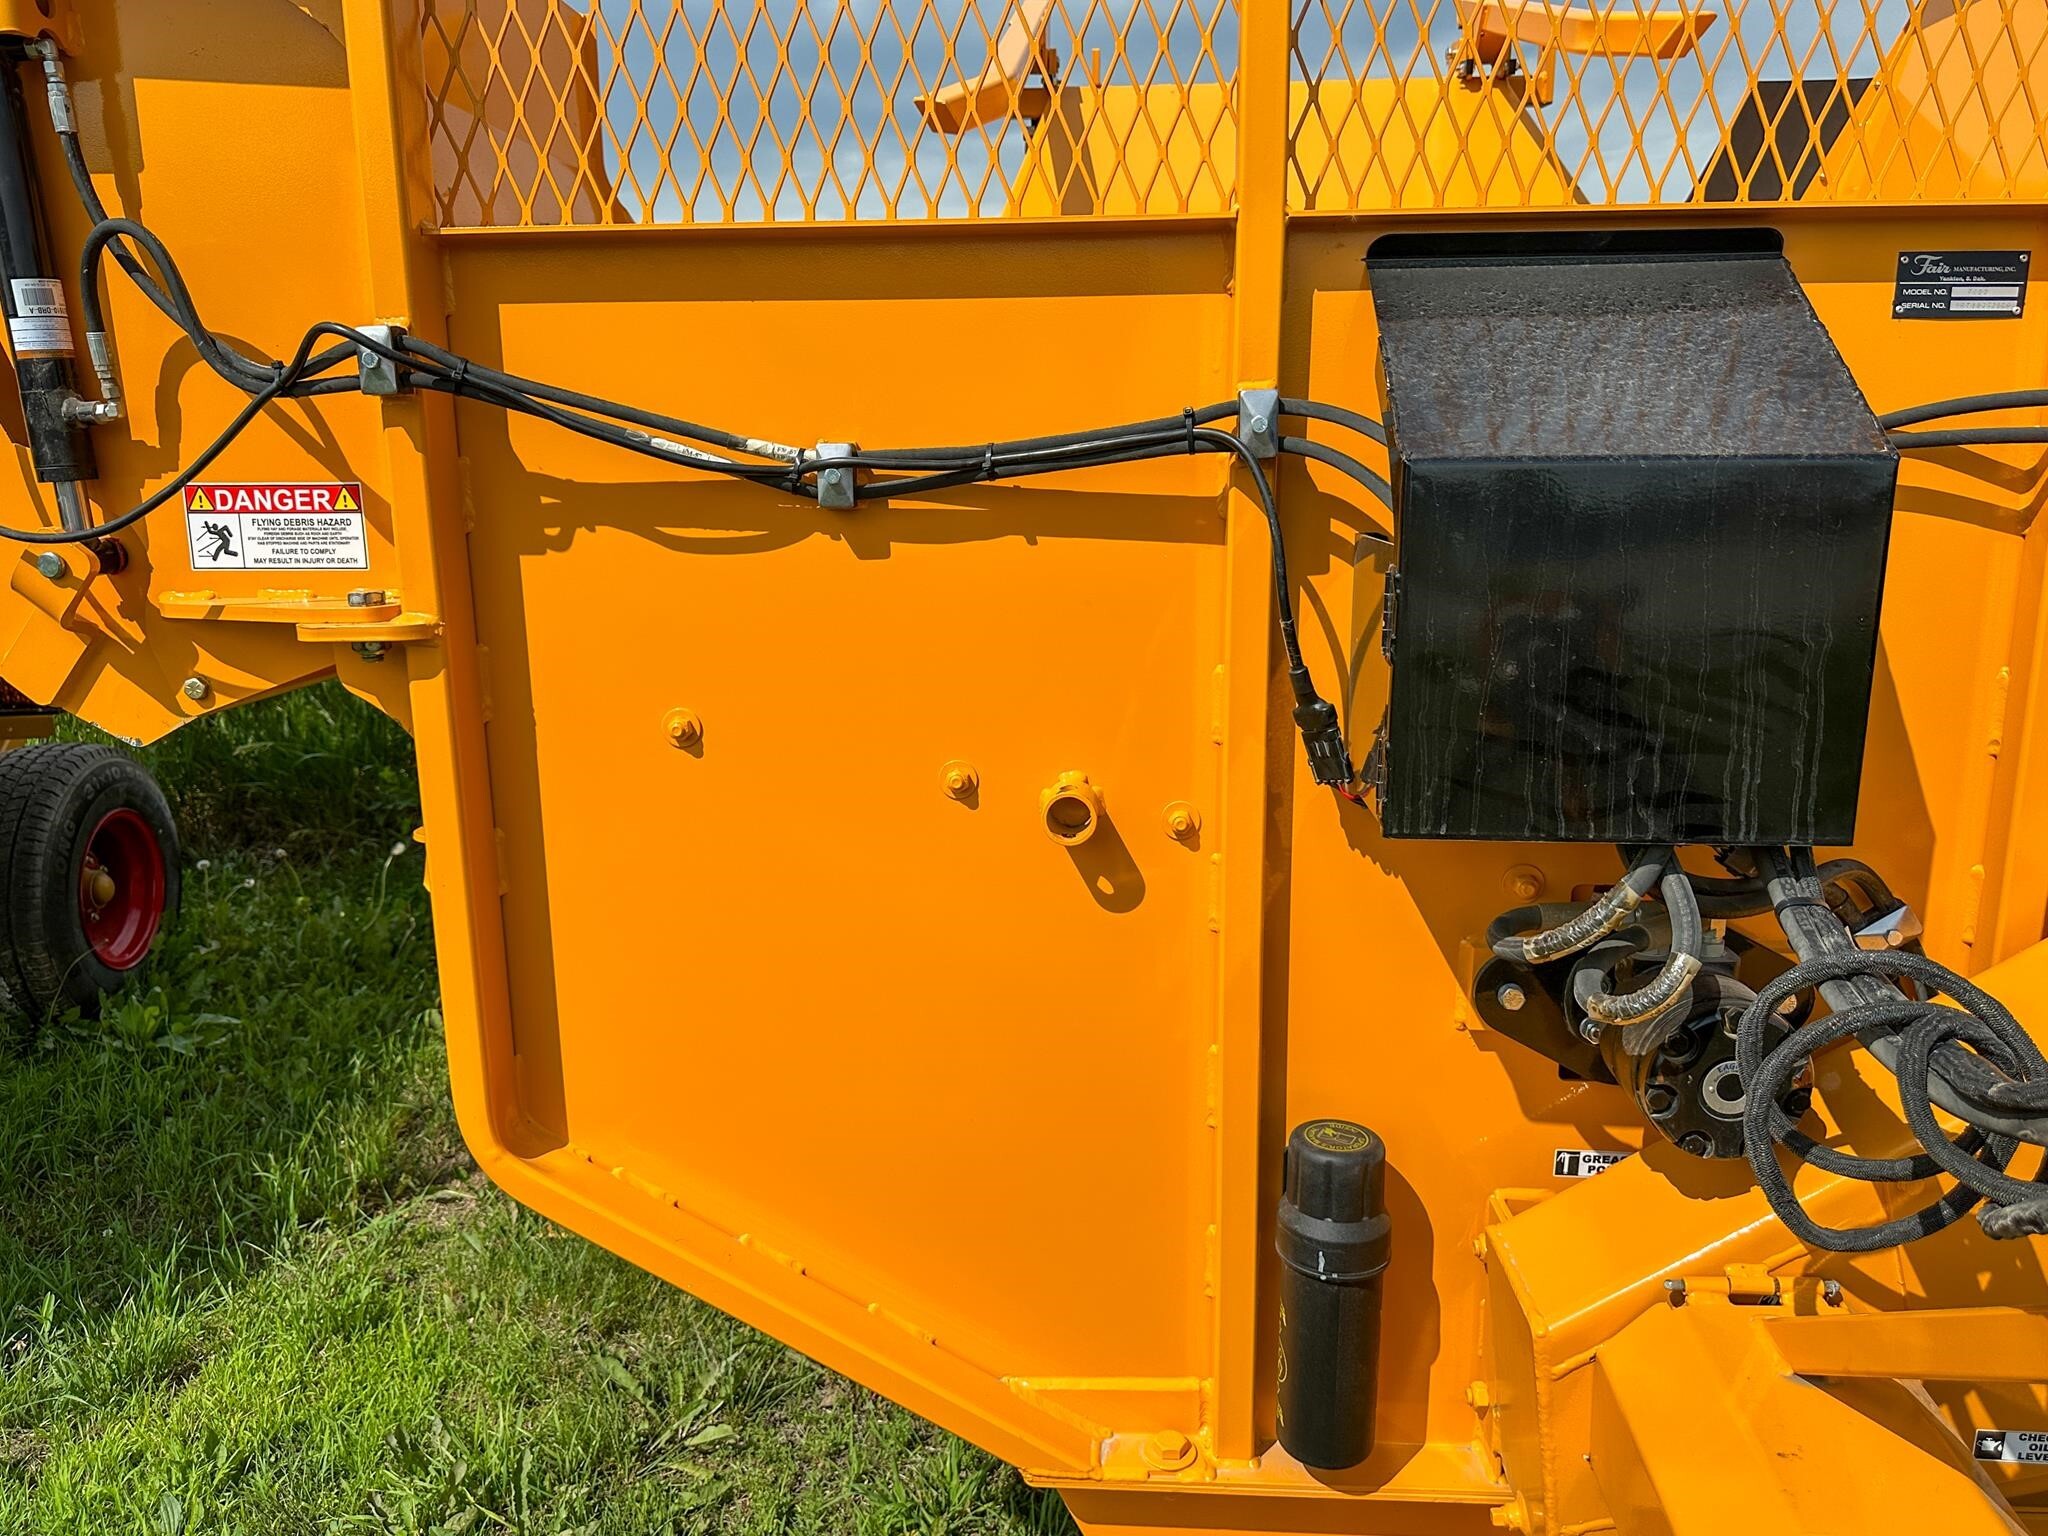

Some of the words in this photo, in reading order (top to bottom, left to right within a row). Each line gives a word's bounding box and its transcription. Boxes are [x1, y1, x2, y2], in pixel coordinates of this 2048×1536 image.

[1910, 254, 1952, 276] Fair
[214, 489, 333, 510] DANGER
[2019, 1433, 2048, 1442] CHE
